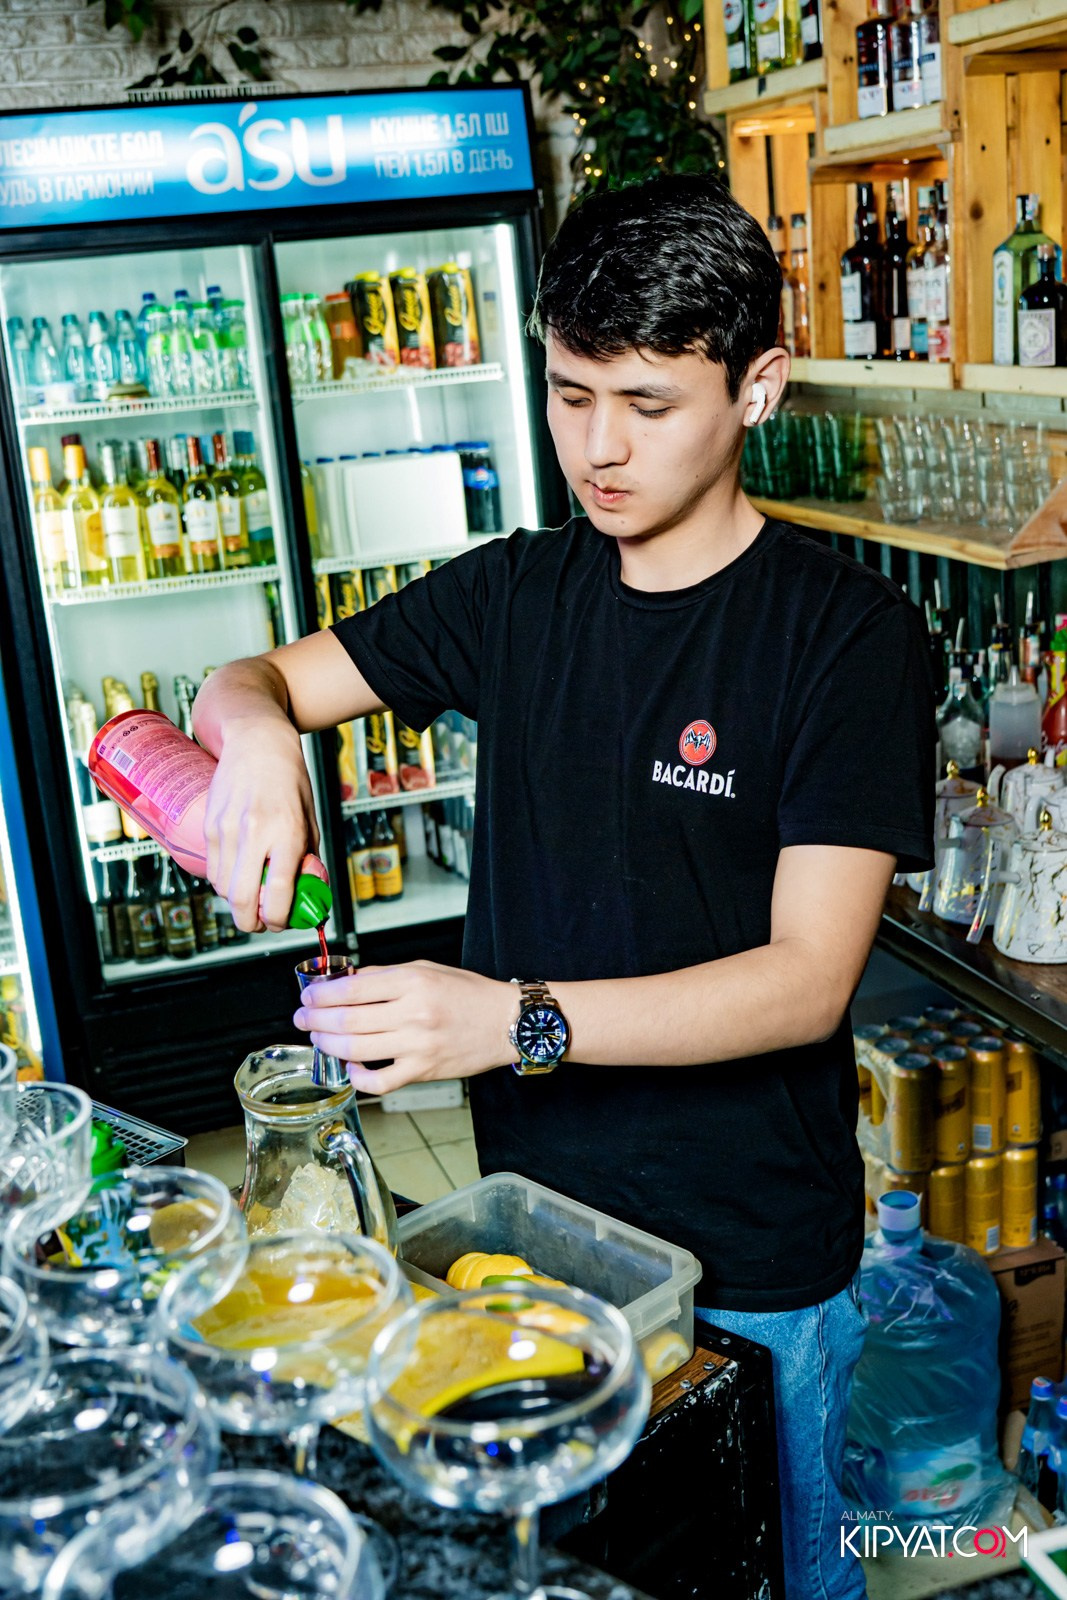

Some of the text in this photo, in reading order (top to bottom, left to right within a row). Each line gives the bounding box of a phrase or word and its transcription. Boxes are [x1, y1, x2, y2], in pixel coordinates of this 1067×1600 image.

[374, 149, 411, 179] ПЕЙ
[451, 149, 465, 174] В
[469, 149, 514, 174] ДЕНЬ
[38, 176, 53, 203] В
